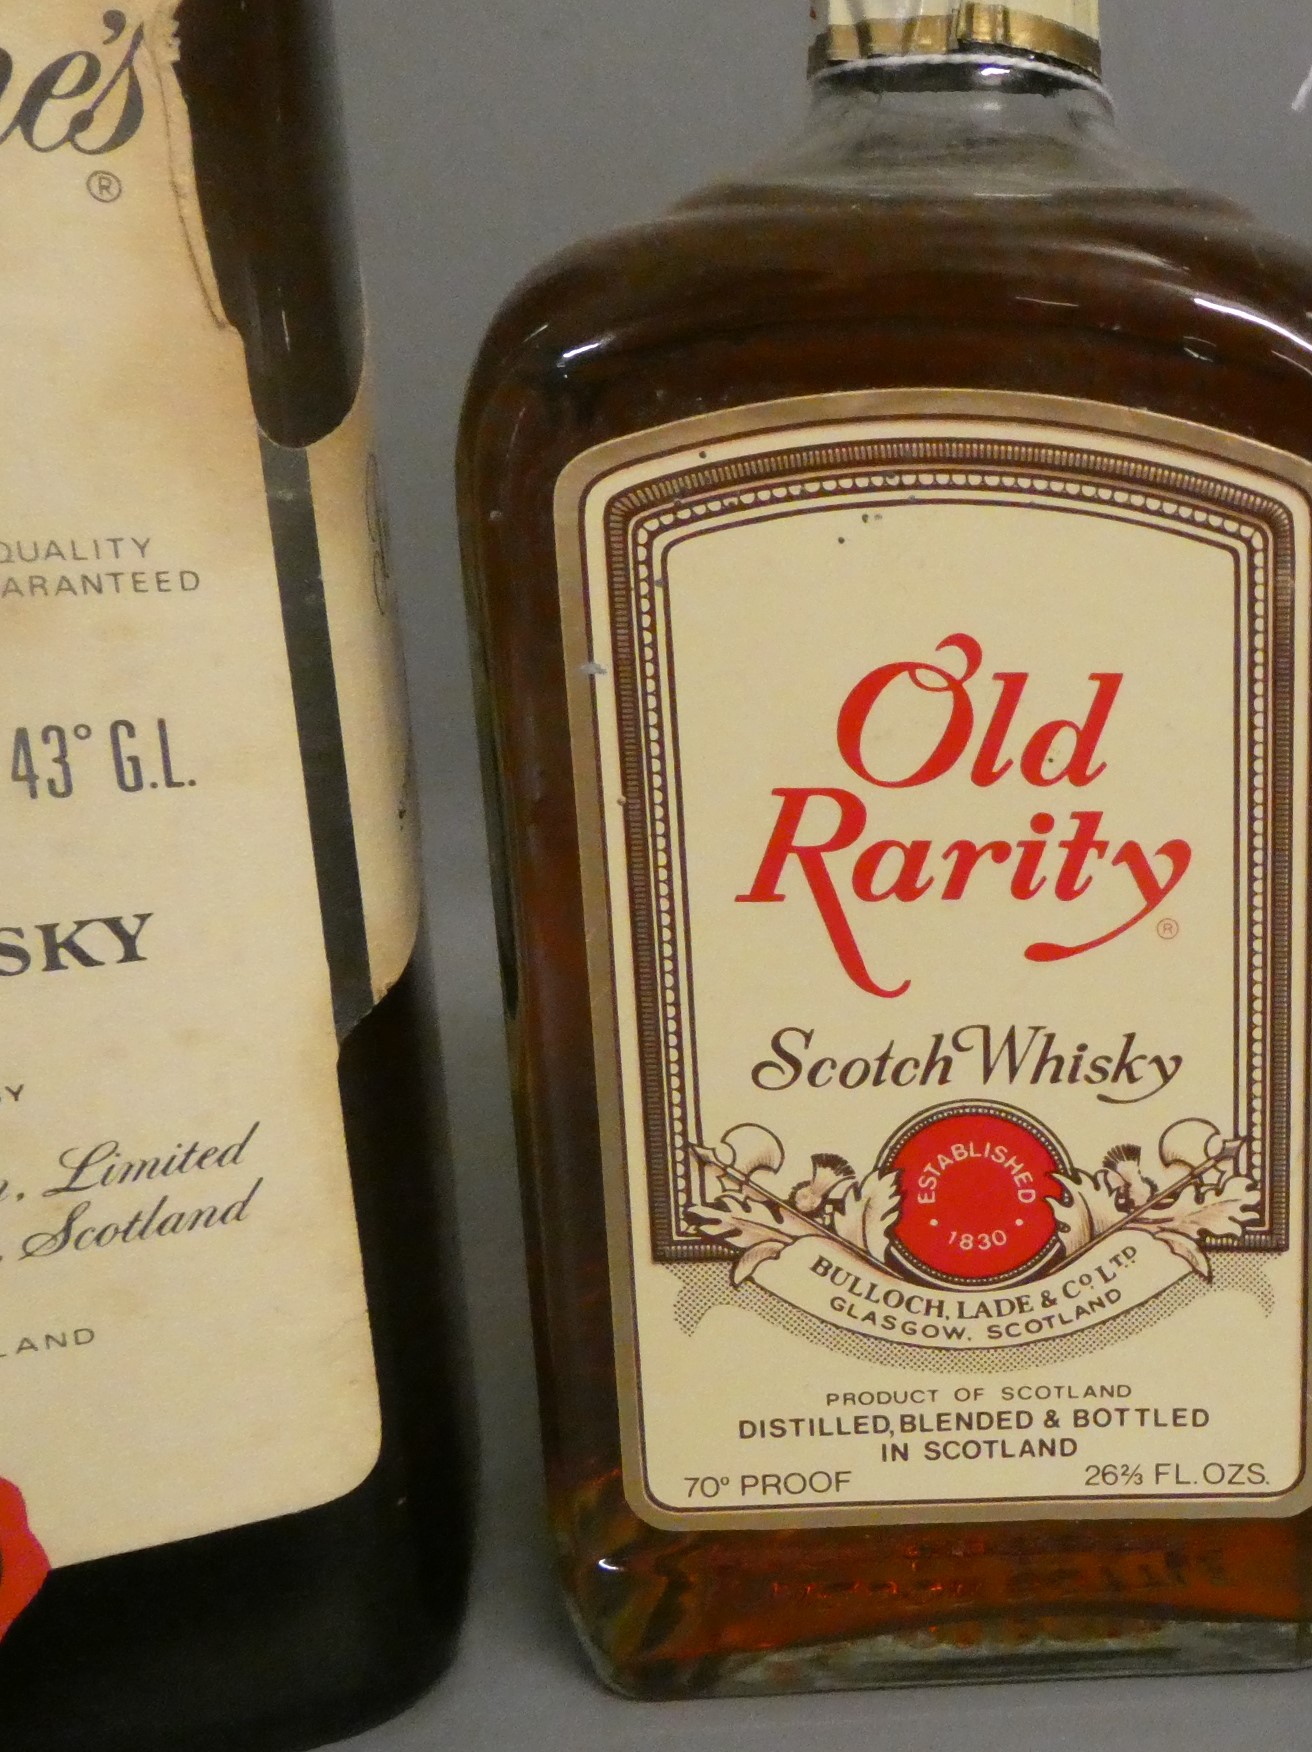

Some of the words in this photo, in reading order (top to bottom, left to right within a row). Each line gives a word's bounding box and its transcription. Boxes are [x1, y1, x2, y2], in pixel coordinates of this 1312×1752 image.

[0, 9, 145, 156] e's
[836, 632, 1124, 789] Old
[109, 717, 197, 793] G.L.
[734, 787, 1192, 998] Rarity
[749, 1026, 954, 1091] Scotch
[951, 1023, 1183, 1104] Whisky
[42, 1120, 260, 1197] Limited
[917, 1141, 1036, 1204] ESTABLISHED
[17, 1176, 264, 1261] Scotland
[948, 1229, 1008, 1251] 1830
[956, 1295, 1034, 1320] LADE
[1039, 1289, 1057, 1309] &
[987, 1287, 1122, 1340] SCOTLAND
[0, 1327, 96, 1357] AND
[825, 1389, 938, 1406] PRODUCT
[952, 1387, 986, 1403] OF
[1000, 1384, 1133, 1401] SCOTLAND
[1043, 1411, 1062, 1429] &
[1072, 1408, 1211, 1429] BOTTLED
[880, 1444, 910, 1463] IN
[923, 1438, 1079, 1462] SCOTLAND
[740, 1471, 852, 1496] PROOF
